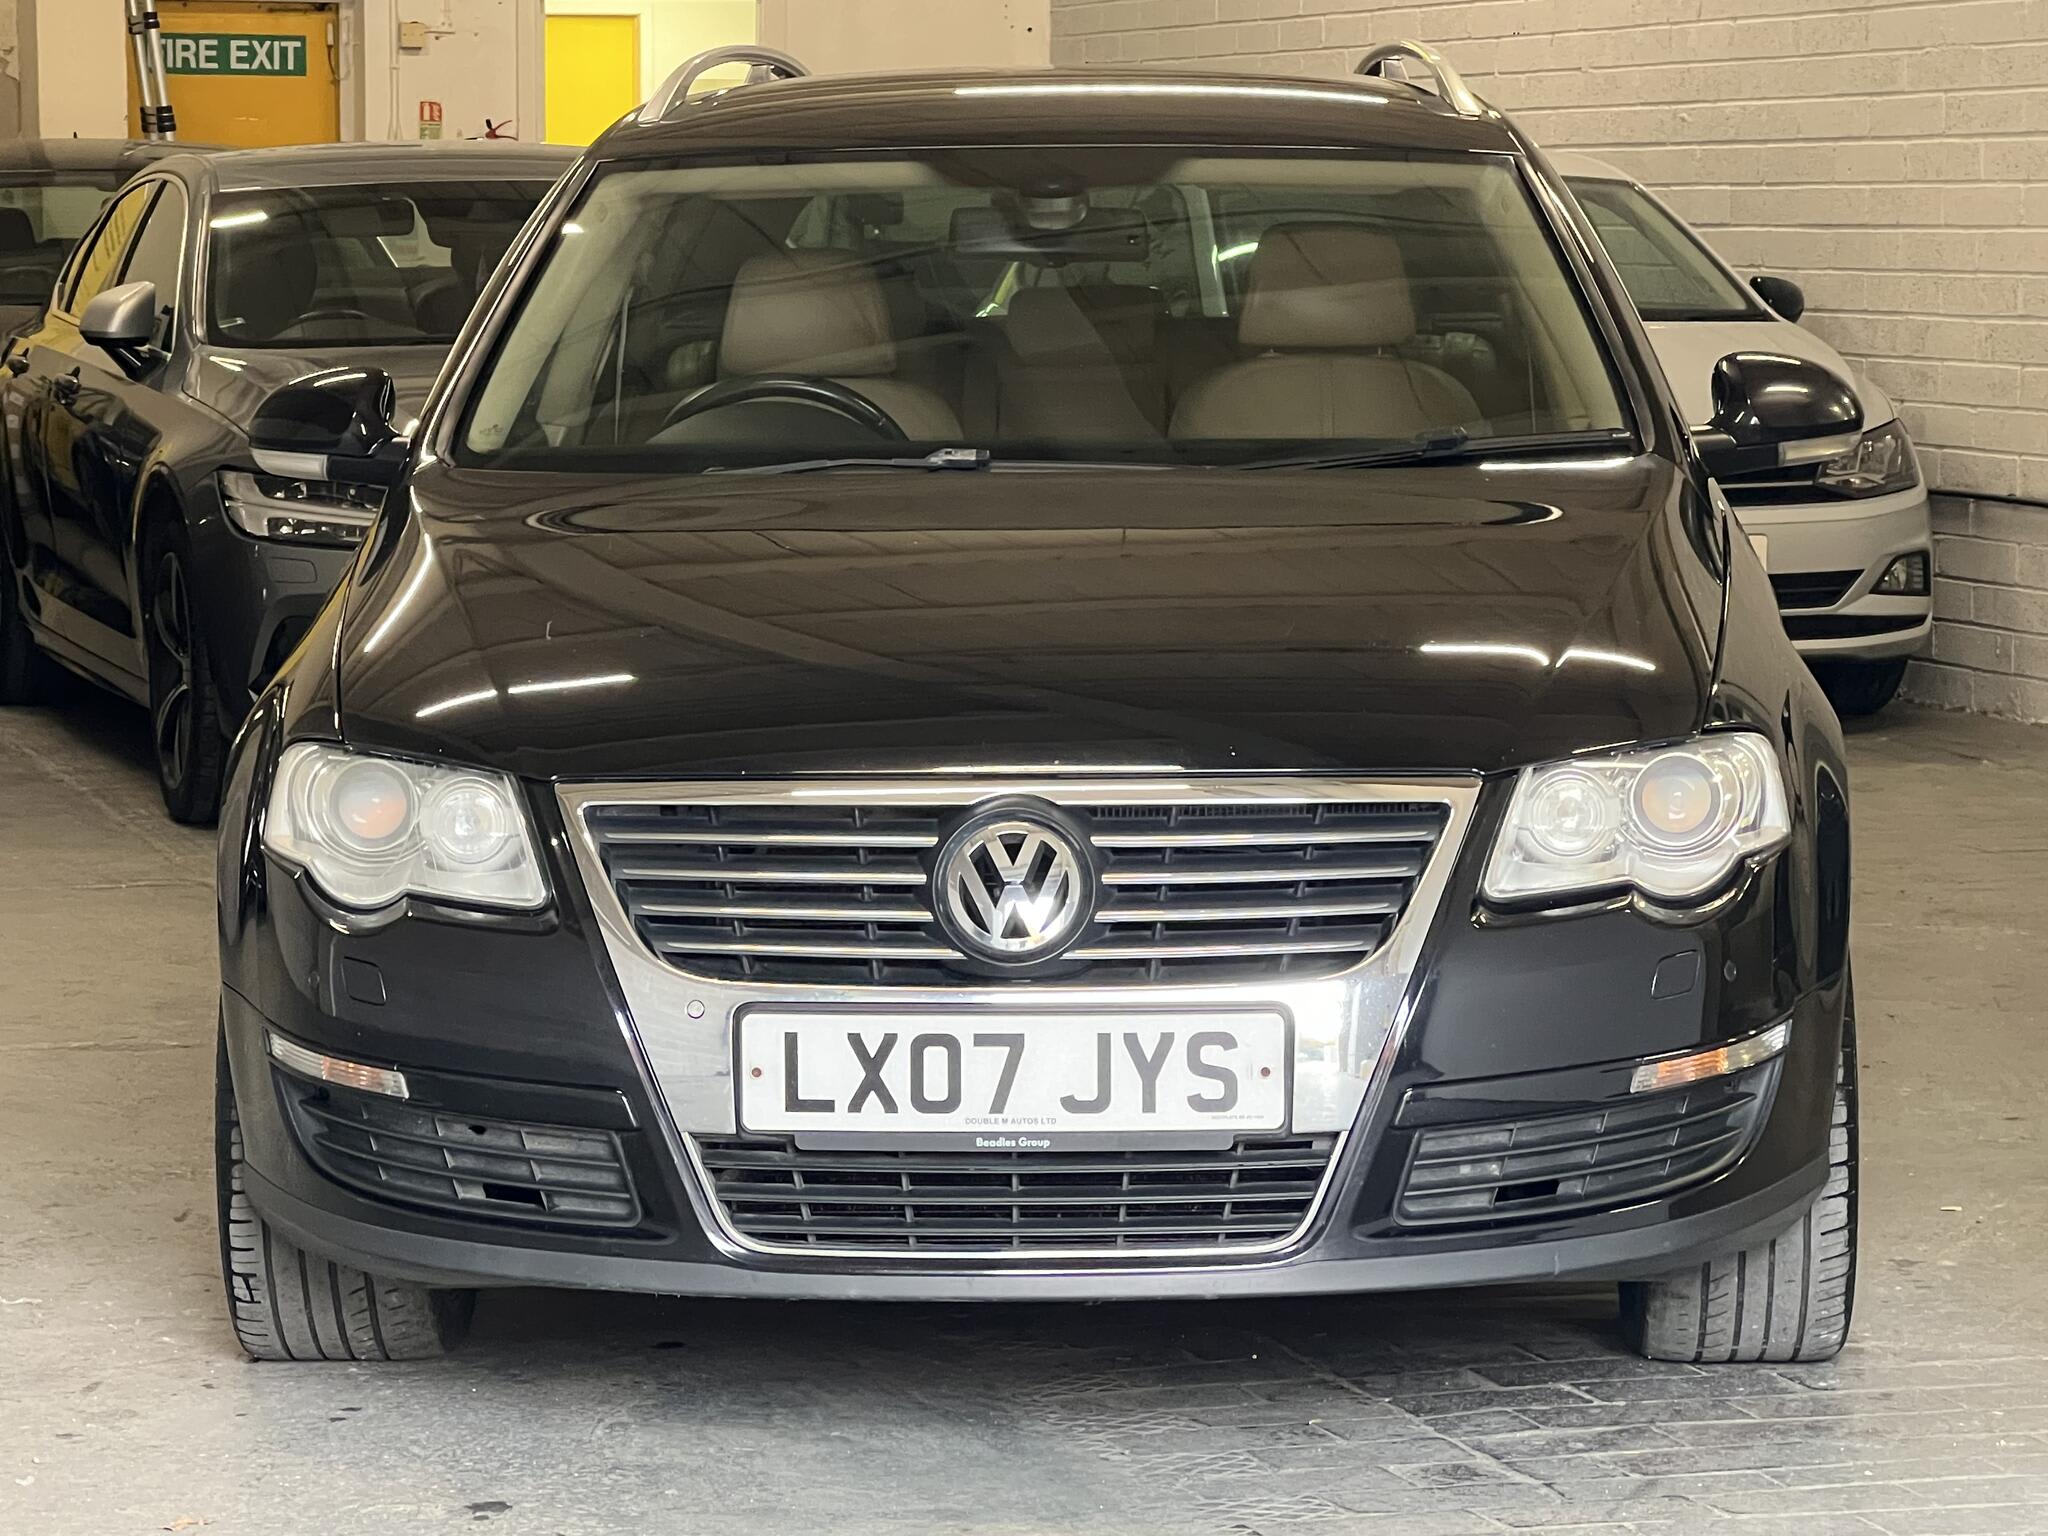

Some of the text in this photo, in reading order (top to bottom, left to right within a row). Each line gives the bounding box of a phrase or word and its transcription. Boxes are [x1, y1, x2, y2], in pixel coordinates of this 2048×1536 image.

[229, 39, 302, 70] EXIT
[784, 1032, 1239, 1114] LX07 JYS
[965, 1117, 1057, 1125] DOUBLE M AUTOS LTD
[975, 1136, 1051, 1149] Beadles Group
